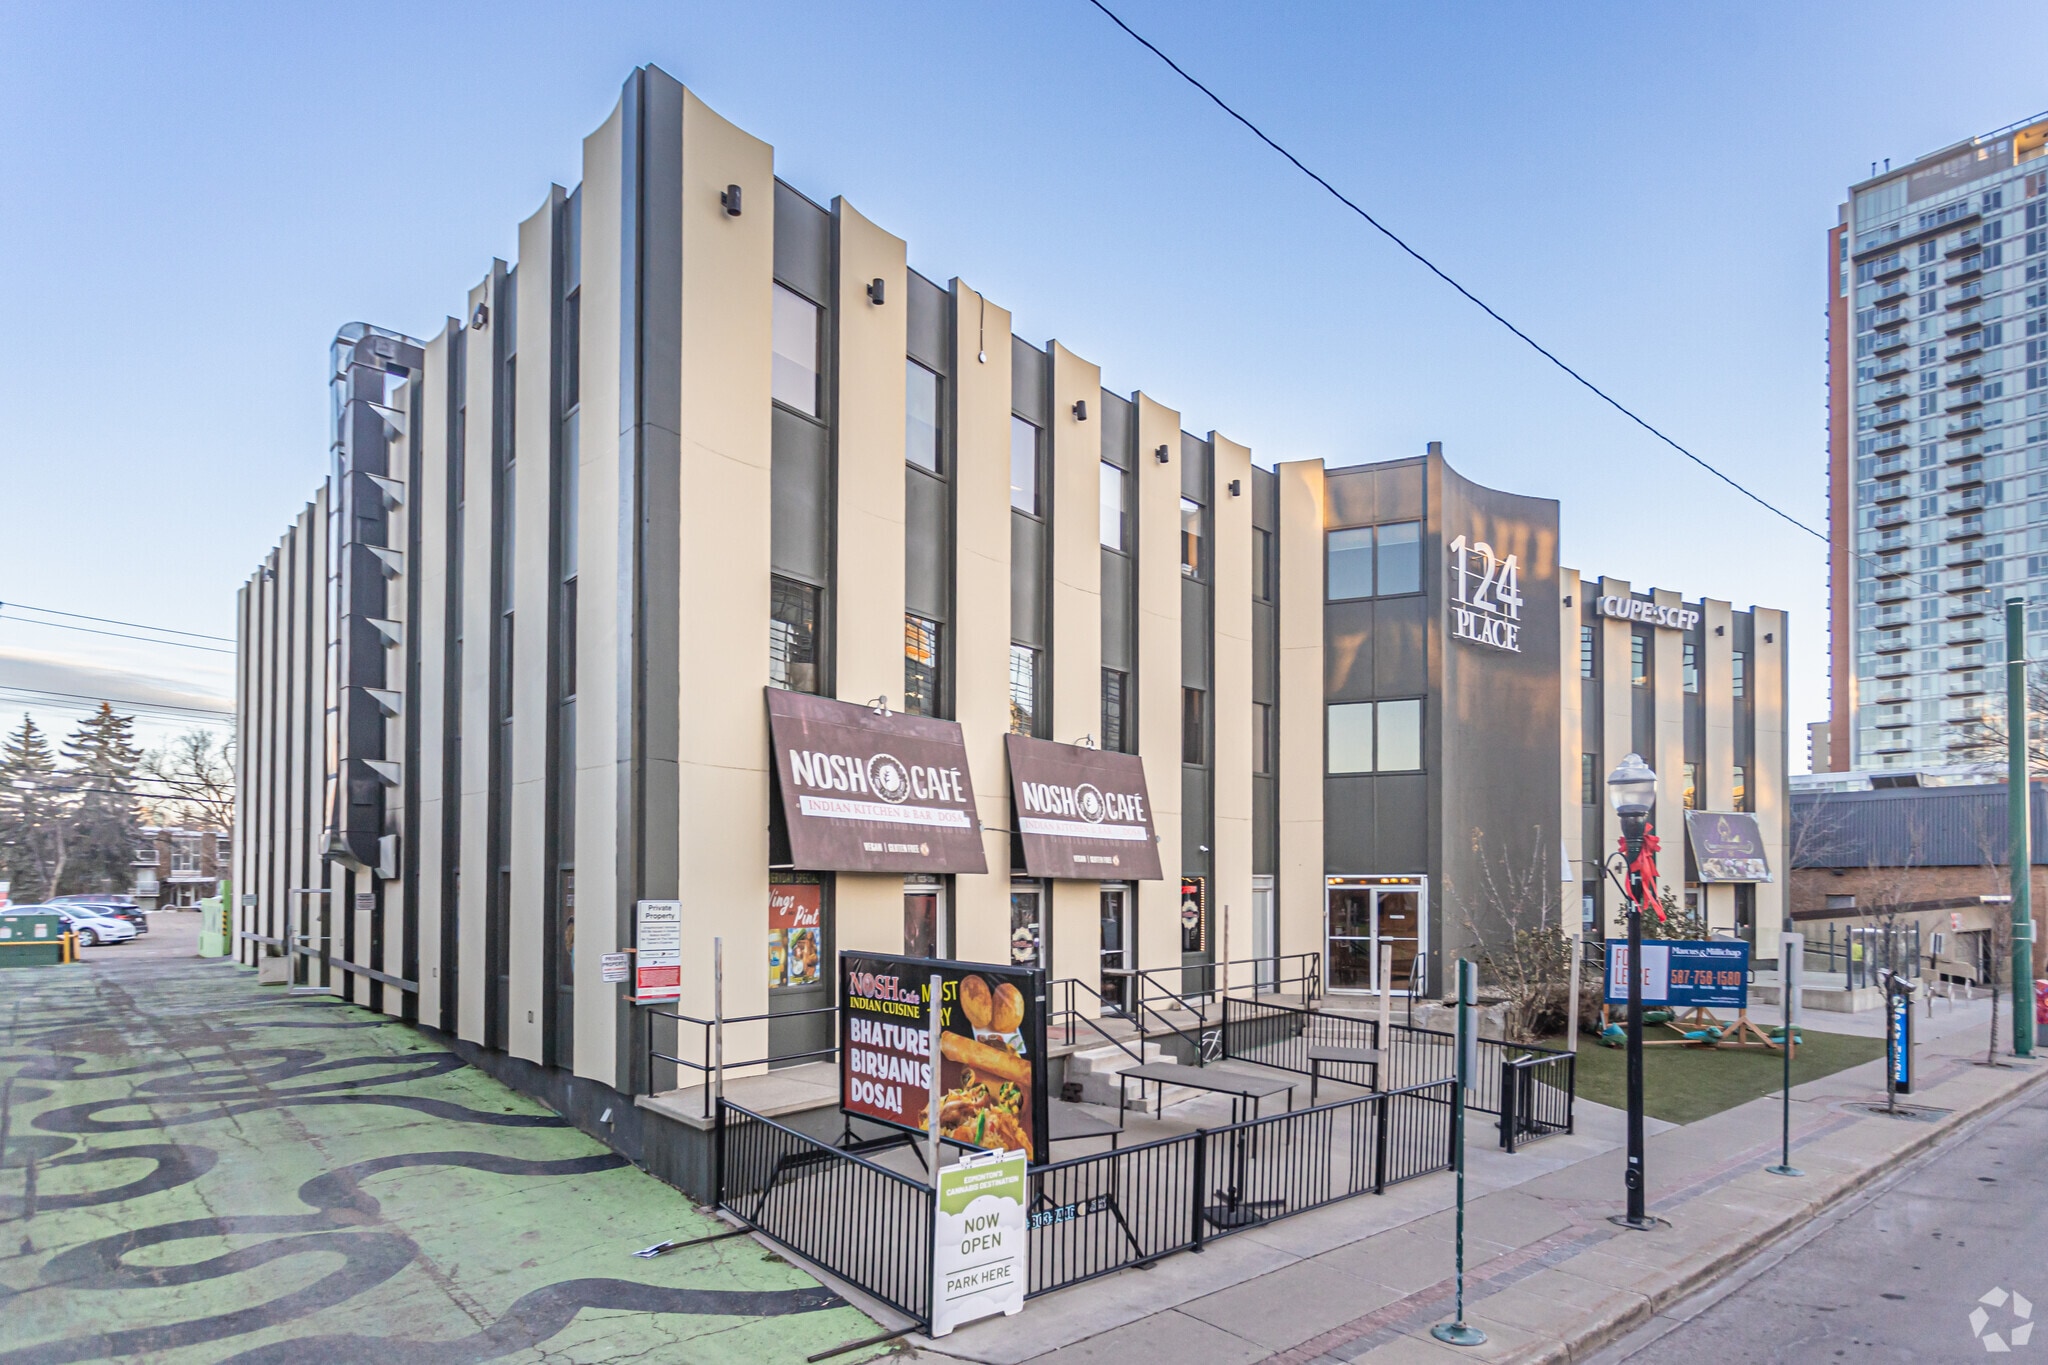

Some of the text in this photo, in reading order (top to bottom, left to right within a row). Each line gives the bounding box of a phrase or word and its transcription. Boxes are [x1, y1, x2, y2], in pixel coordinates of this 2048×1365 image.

[1450, 534, 1523, 619] 124
[1456, 609, 1521, 652] PLACE
[789, 749, 967, 802] NOSH CAFÉ
[808, 799, 964, 822] INDIAN KITCHEN & BAR DOSA
[1022, 781, 1147, 822] NOSH CAFÉ
[646, 912, 675, 920] Property
[793, 905, 819, 927] Pint
[1672, 946, 1699, 955] Marcus
[849, 971, 899, 1001] NOSH
[1615, 967, 1650, 985] LEE
[921, 981, 958, 1003] MST
[849, 996, 920, 1019] INDIAN CUISINE
[927, 1007, 952, 1026] RY
[851, 1048, 931, 1090] BIRYANIS
[851, 1077, 903, 1114] DOSA!
[946, 1183, 979, 1197] CANNABIS
[965, 1212, 1000, 1234] NOW
[961, 1232, 1001, 1255] OPEN
[947, 1264, 1011, 1293] PARK HERE
